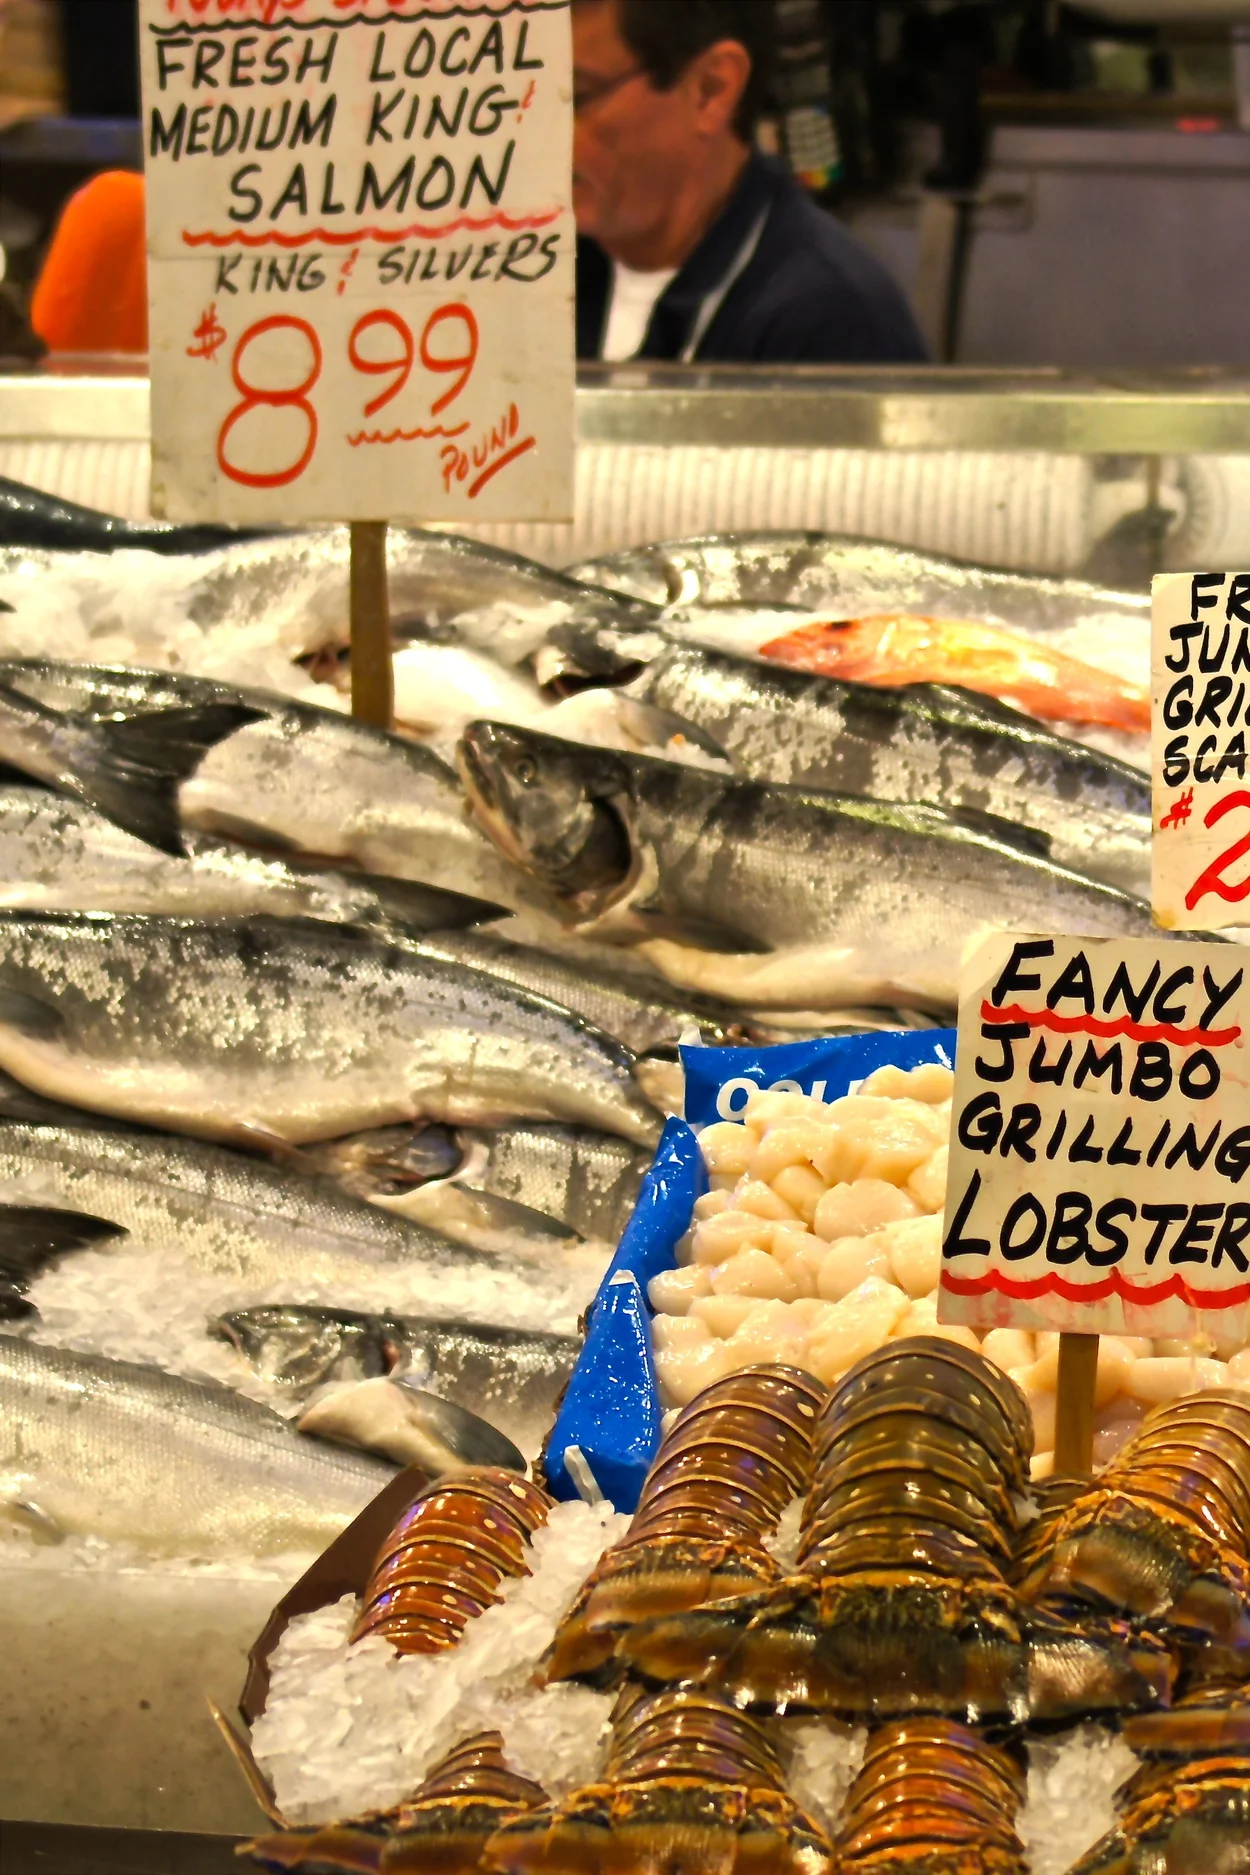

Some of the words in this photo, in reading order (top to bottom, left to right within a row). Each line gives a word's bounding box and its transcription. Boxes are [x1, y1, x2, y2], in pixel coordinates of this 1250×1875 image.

[156, 33, 338, 90] FRESH
[370, 20, 544, 83] LOCAL
[150, 94, 336, 161] MEDIUM
[228, 140, 516, 223] SALMON
[215, 252, 327, 294] KING
[378, 233, 561, 284] SILVERS
[348, 302, 479, 417] 99
[440, 402, 519, 495] POUND
[991, 939, 1244, 1032] FANCY
[974, 1021, 1221, 1102] JUMBO
